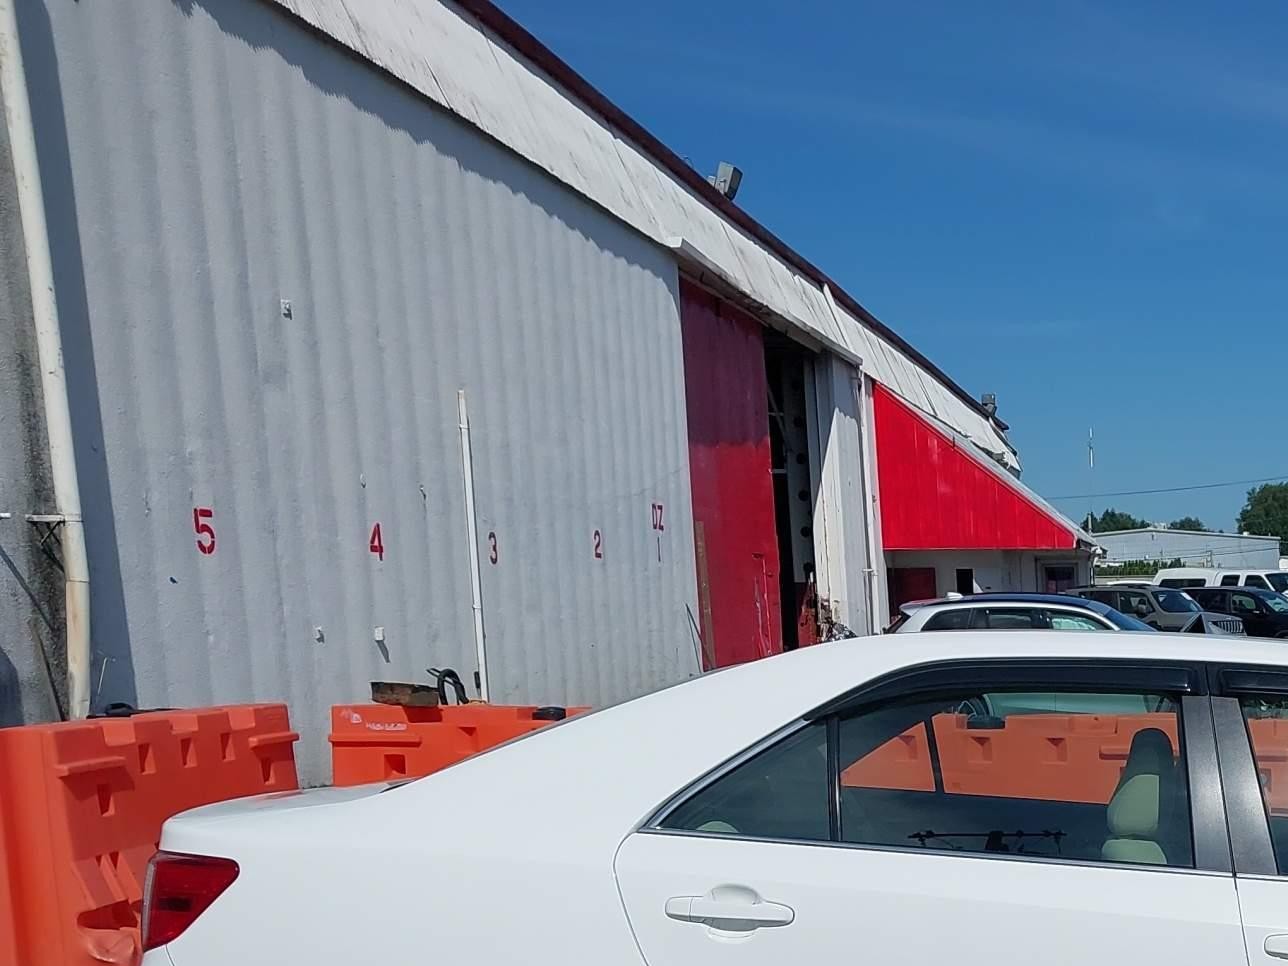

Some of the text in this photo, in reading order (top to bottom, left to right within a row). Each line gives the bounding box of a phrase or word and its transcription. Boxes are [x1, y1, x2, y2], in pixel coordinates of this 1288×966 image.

[192, 507, 217, 556] 5
[368, 522, 385, 561] 4
[487, 531, 499, 565] 3
[593, 530, 603, 559] 2
